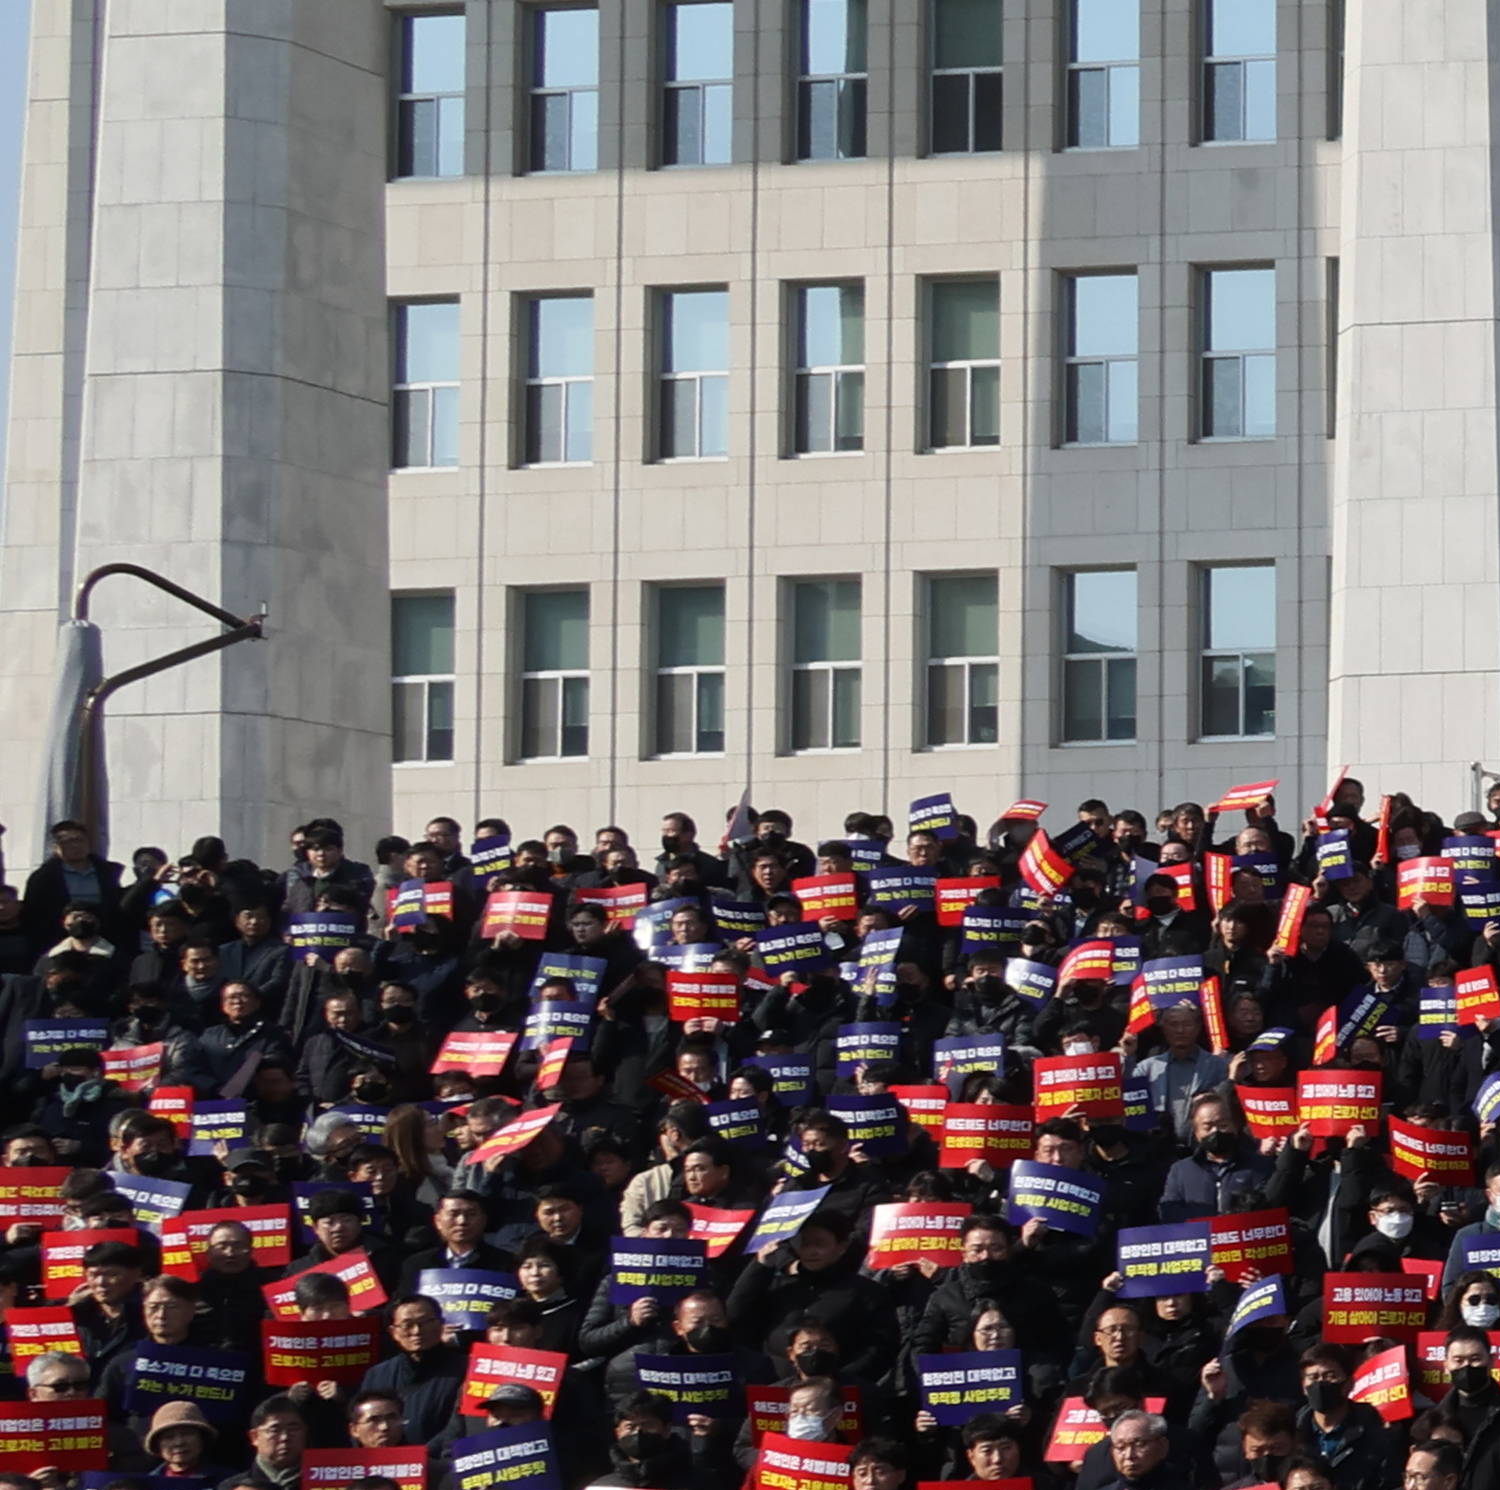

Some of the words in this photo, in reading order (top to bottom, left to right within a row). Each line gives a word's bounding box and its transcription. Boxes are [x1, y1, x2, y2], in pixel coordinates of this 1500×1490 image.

[1121, 1243, 1162, 1259] 현장안전
[1163, 1239, 1207, 1254] 대책없고
[1126, 1263, 1157, 1277] 무작정
[1160, 1259, 1202, 1273] 사업주탓
[922, 1371, 965, 1386] 현장안전
[967, 1367, 1016, 1382] 대책없고
[929, 1392, 961, 1405] 무작정
[963, 1388, 1010, 1402] 사업주탓
